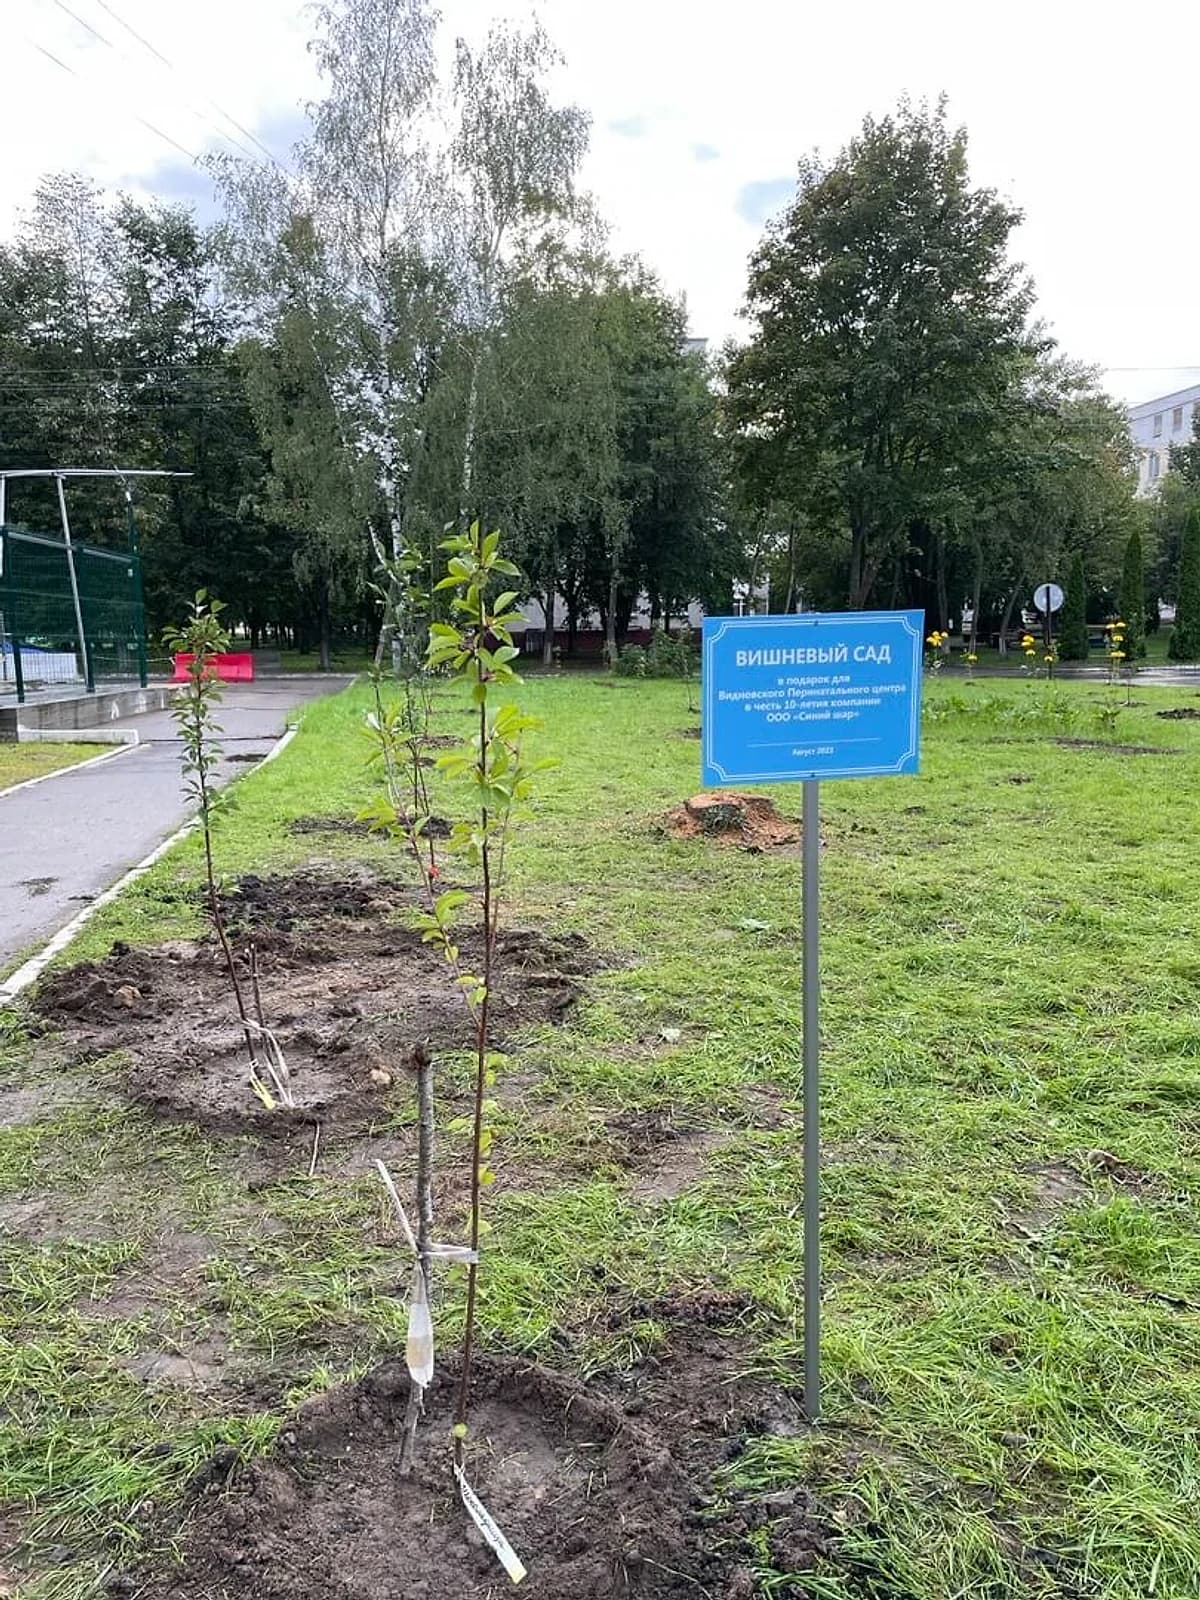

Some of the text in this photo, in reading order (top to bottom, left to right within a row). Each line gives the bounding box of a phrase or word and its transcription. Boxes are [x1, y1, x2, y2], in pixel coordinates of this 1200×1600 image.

[736, 643, 891, 666] ВИШНЕВЫЙ САД
[787, 677, 830, 687] подарок
[831, 675, 850, 685] для
[719, 683, 906, 700] Видновского Перинатального центра
[754, 702, 781, 711] честь
[784, 700, 829, 709] 10-летия
[831, 698, 881, 708] компании
[766, 710, 860, 722] ООО «Синий шар»
[791, 748, 816, 757] Август
